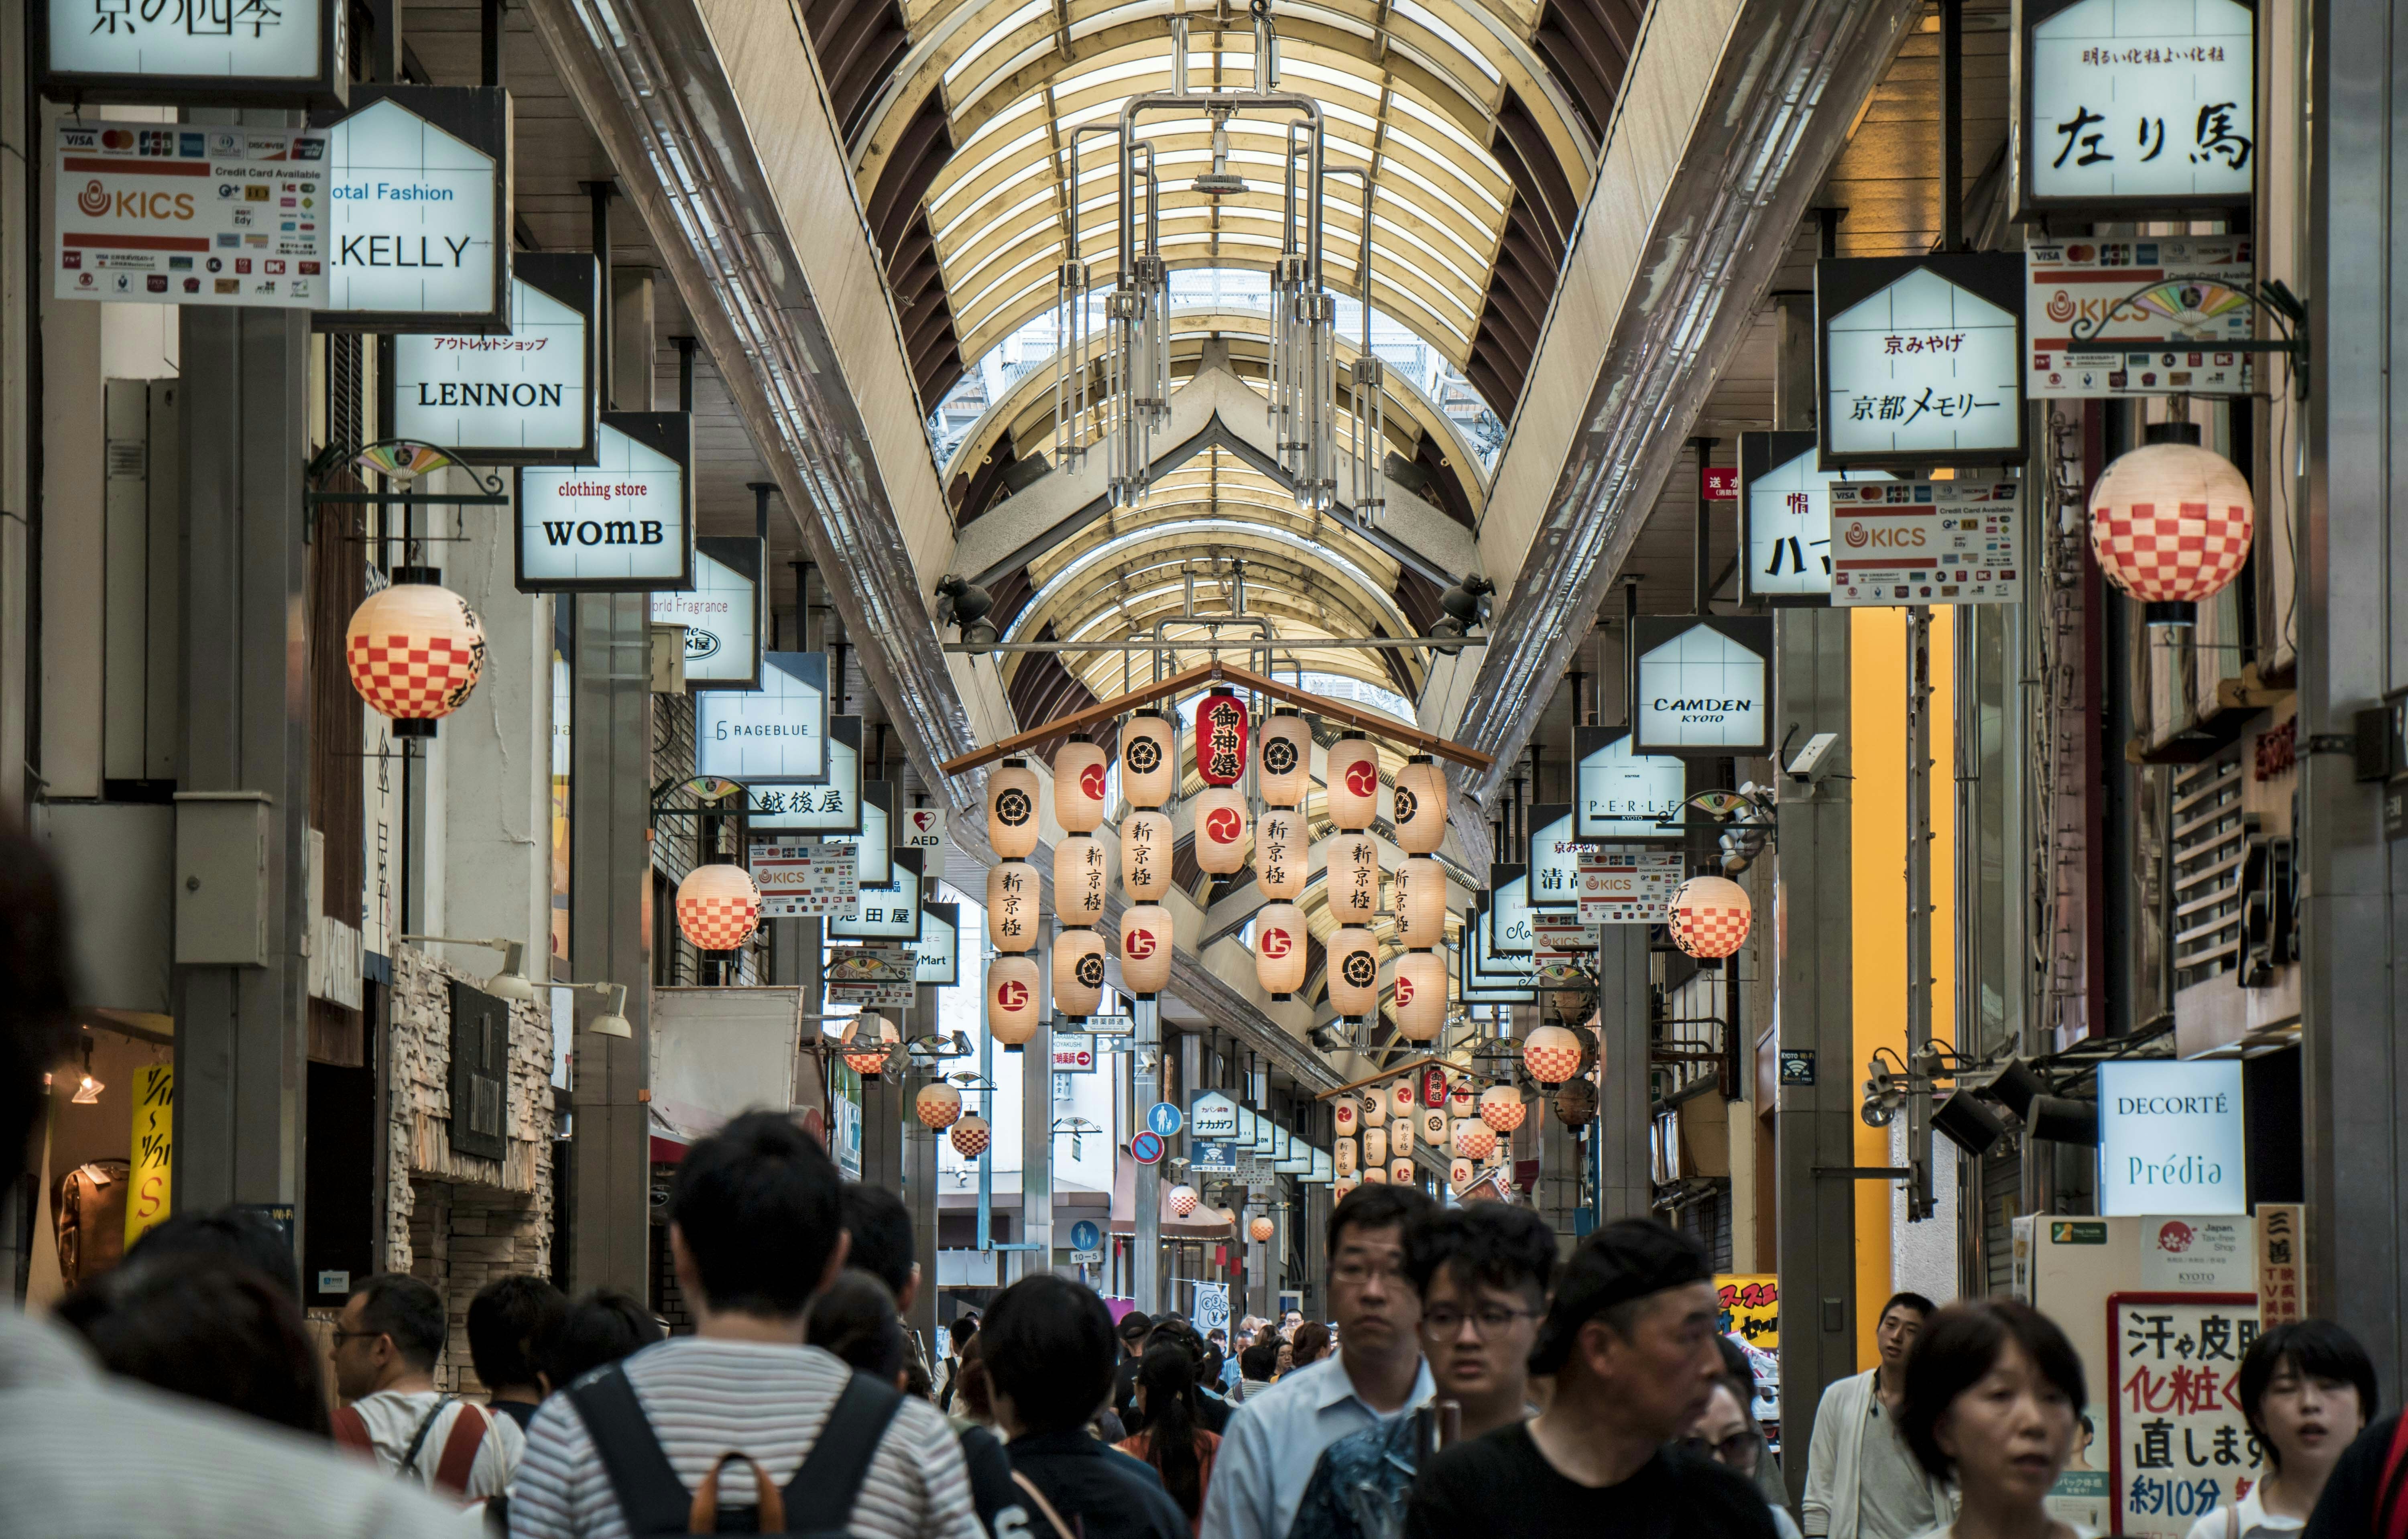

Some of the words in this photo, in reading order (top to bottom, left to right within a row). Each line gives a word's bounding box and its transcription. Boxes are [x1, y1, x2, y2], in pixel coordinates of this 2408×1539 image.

[66, 135, 94, 146] VISA
[215, 167, 246, 176] Credit
[248, 169, 273, 177] Card
[276, 169, 321, 179] Available
[332, 183, 368, 201] otal
[378, 183, 454, 201] Fashion
[116, 190, 194, 220] KICS
[2036, 251, 2060, 260] VISA
[1884, 333, 1966, 354] 京みやげ
[418, 383, 563, 407] LENNON
[1849, 387, 2000, 425] 京都メモリー
[558, 482, 611, 500] clothing
[615, 482, 647, 496] store
[1871, 527, 1926, 547] KICS
[653, 599, 672, 612] orld
[677, 598, 728, 614] Fragrance
[1653, 699, 1751, 712] CAMDEN
[734, 725, 808, 736] RAGEBLUE
[760, 790, 843, 813] 越後屋
[910, 836, 939, 846] AED
[1131, 821, 1153, 886] 新京極
[1265, 819, 1288, 884] 新京極
[773, 872, 805, 883] KICS
[1084, 845, 1102, 911] 新京極
[1350, 843, 1371, 909] 新京極
[1600, 879, 1631, 890] KICS
[1001, 872, 1023, 937] 新京極
[1394, 868, 1409, 933] 新京極
[916, 955, 946, 967] yMart
[2118, 1093, 2229, 1115] DECORTÉ
[1196, 1119, 1233, 1129] ナカガワ
[2127, 1154, 2223, 1185] Prédia
[273, 1208, 293, 1220] Wi-Fi
[2205, 1224, 2235, 1233] Japan.
[2202, 1234, 2236, 1242] Tax-free
[2214, 1244, 2236, 1252] Shop
[2178, 1273, 2215, 1281] KYOTO
[2129, 1474, 2221, 1517] 約10分
